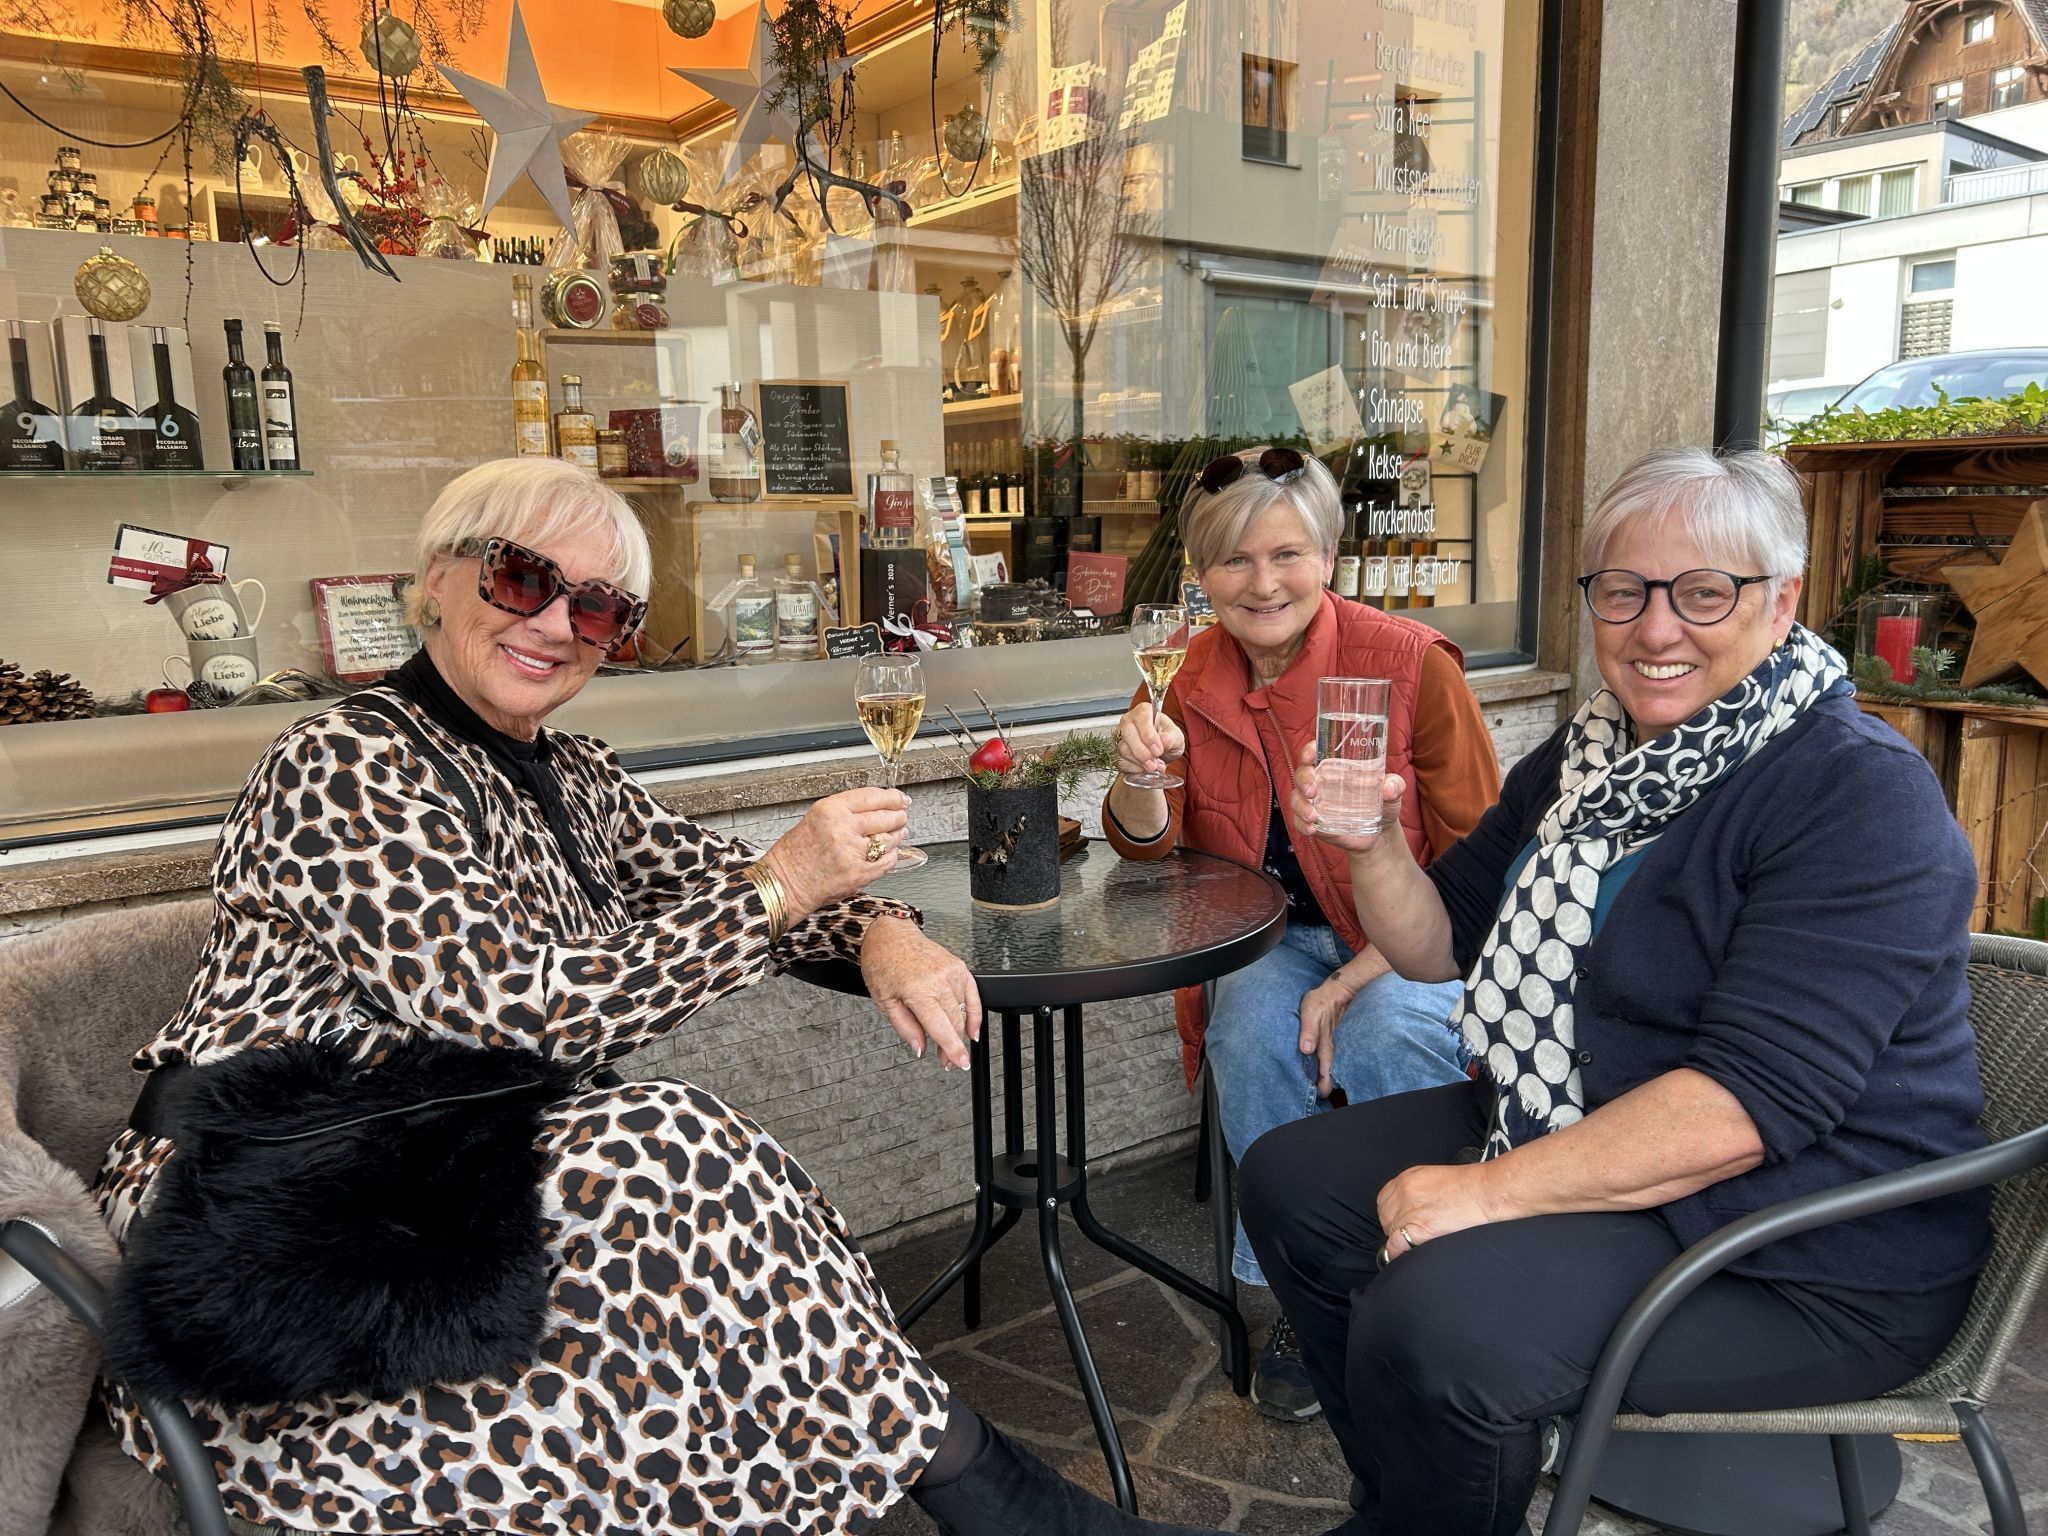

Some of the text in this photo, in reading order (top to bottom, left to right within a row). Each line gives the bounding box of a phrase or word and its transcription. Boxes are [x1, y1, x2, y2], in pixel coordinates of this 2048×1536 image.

[1374, 94, 1404, 134] Sura
[1373, 214, 1446, 257] Marmeladen
[1372, 272, 1467, 326] Saft und Sirupe
[1372, 330, 1453, 369] Gin und Biere
[770, 390, 810, 404] Original
[17, 412, 37, 436] 9
[1370, 388, 1424, 436] Schnäpse
[161, 414, 180, 437] 6
[769, 444, 780, 452] Als
[1458, 453, 1478, 467] DICH
[1368, 445, 1403, 480] Kekse
[1367, 500, 1436, 536] Trockenobst
[144, 552, 187, 567] GUTSCHEIN
[1365, 555, 1389, 590] und
[1393, 553, 1427, 588] vieles
[1431, 552, 1461, 585] mehr
[887, 563, 895, 581] 2020
[193, 613, 225, 629] Liebe
[213, 671, 247, 680] Liebe
